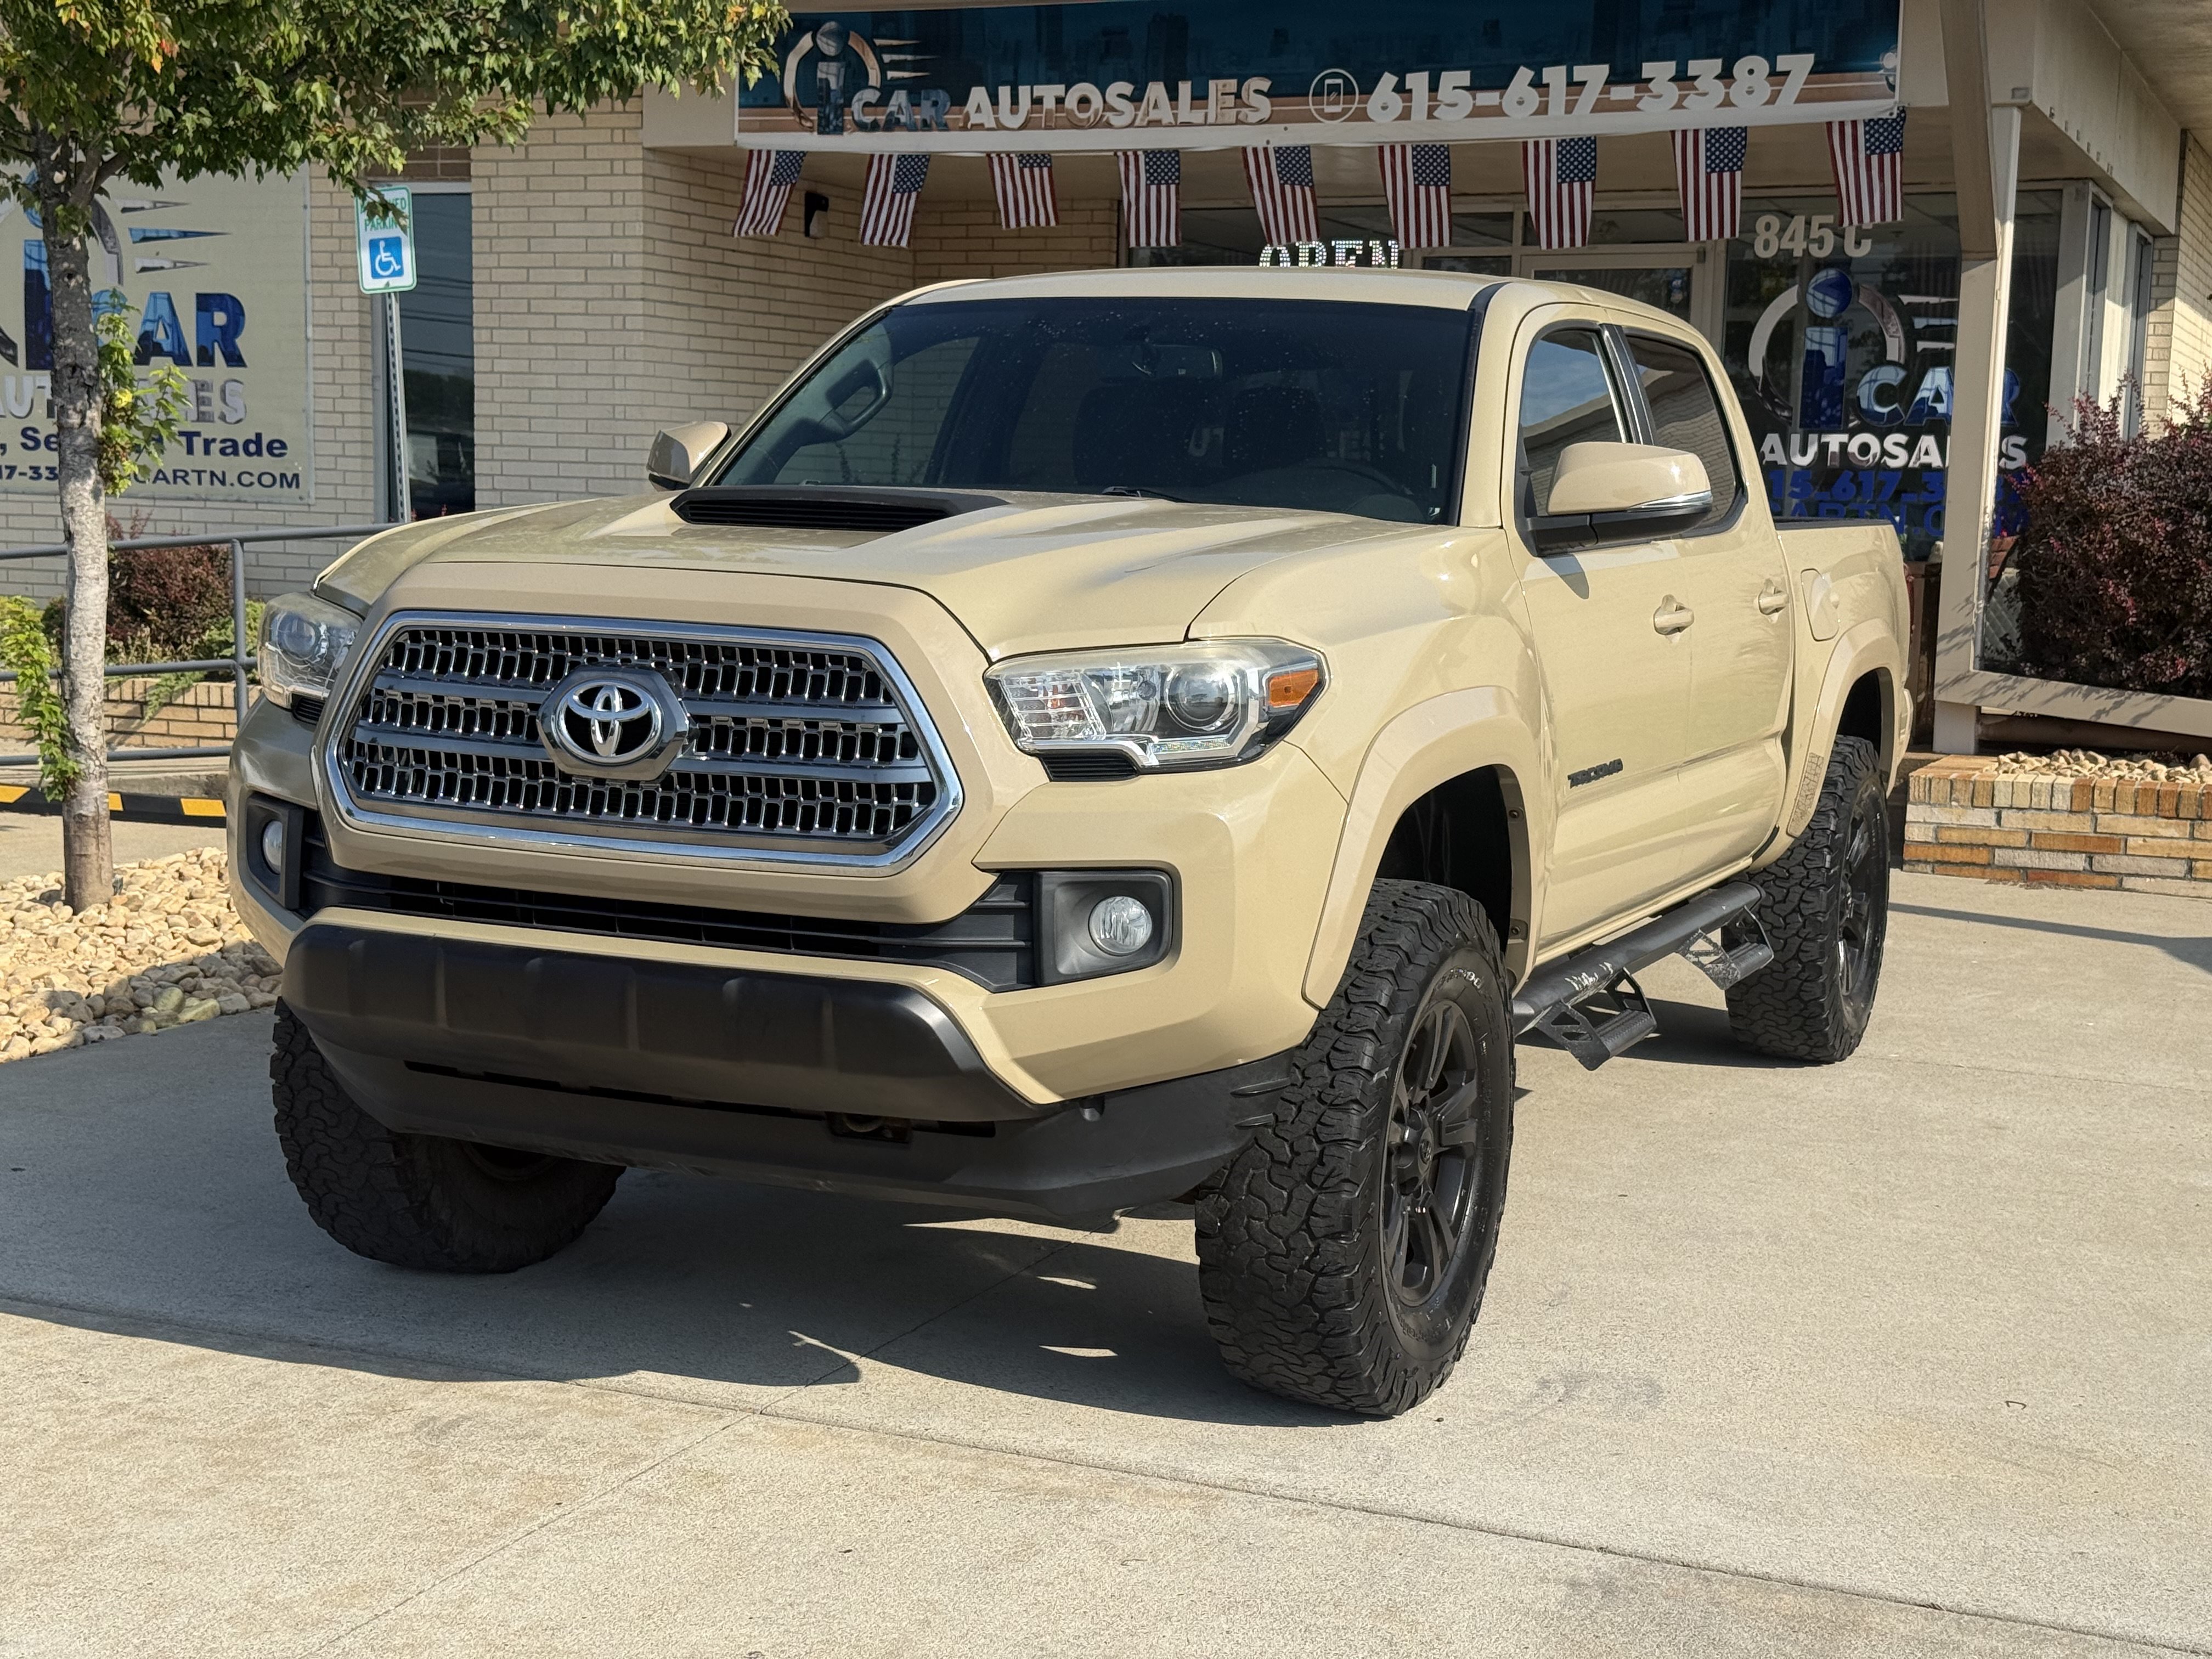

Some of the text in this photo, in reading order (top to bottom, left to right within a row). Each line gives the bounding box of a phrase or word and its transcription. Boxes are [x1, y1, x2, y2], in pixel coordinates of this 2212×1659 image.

[959, 76, 1272, 129] AUTOSALES
[1367, 53, 1815, 123] 615-617-3387
[1754, 215, 1872, 258] 845 C
[178, 431, 288, 458] Trade
